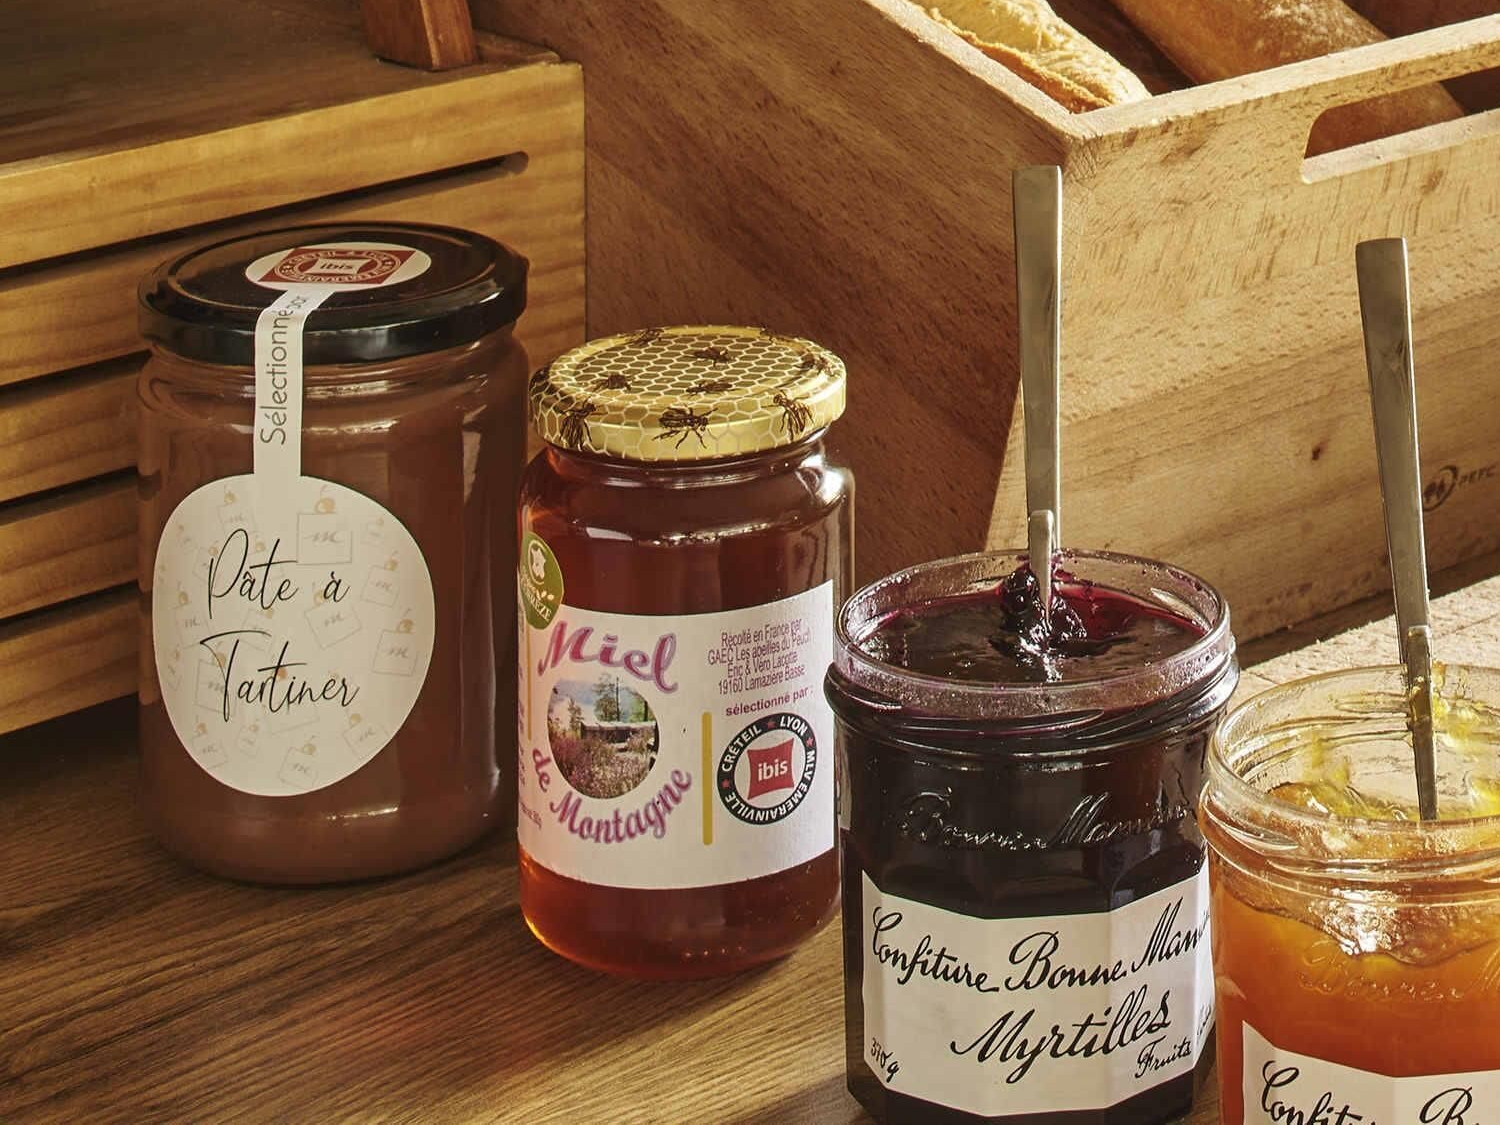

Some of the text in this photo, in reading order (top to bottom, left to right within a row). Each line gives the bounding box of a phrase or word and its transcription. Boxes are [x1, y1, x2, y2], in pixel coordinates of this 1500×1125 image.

[319, 261, 354, 271] ibis
[208, 528, 351, 619] Pâte à
[200, 630, 361, 723] Tartiner
[537, 620, 679, 694] Miel
[707, 647, 734, 665] GAEC
[735, 647, 751, 661] Les
[719, 677, 743, 695] 19160
[725, 693, 790, 716] sélectionné
[780, 715, 808, 736] LYON
[532, 747, 552, 794] de
[757, 758, 788, 782] ibis
[804, 750, 816, 780] MLV
[550, 768, 693, 845] Montagne
[872, 906, 1000, 993] Confiture
[1004, 930, 1128, 991] Bonne
[950, 983, 1172, 1085] Myrtilles
[1134, 1035, 1192, 1079] Fruits
